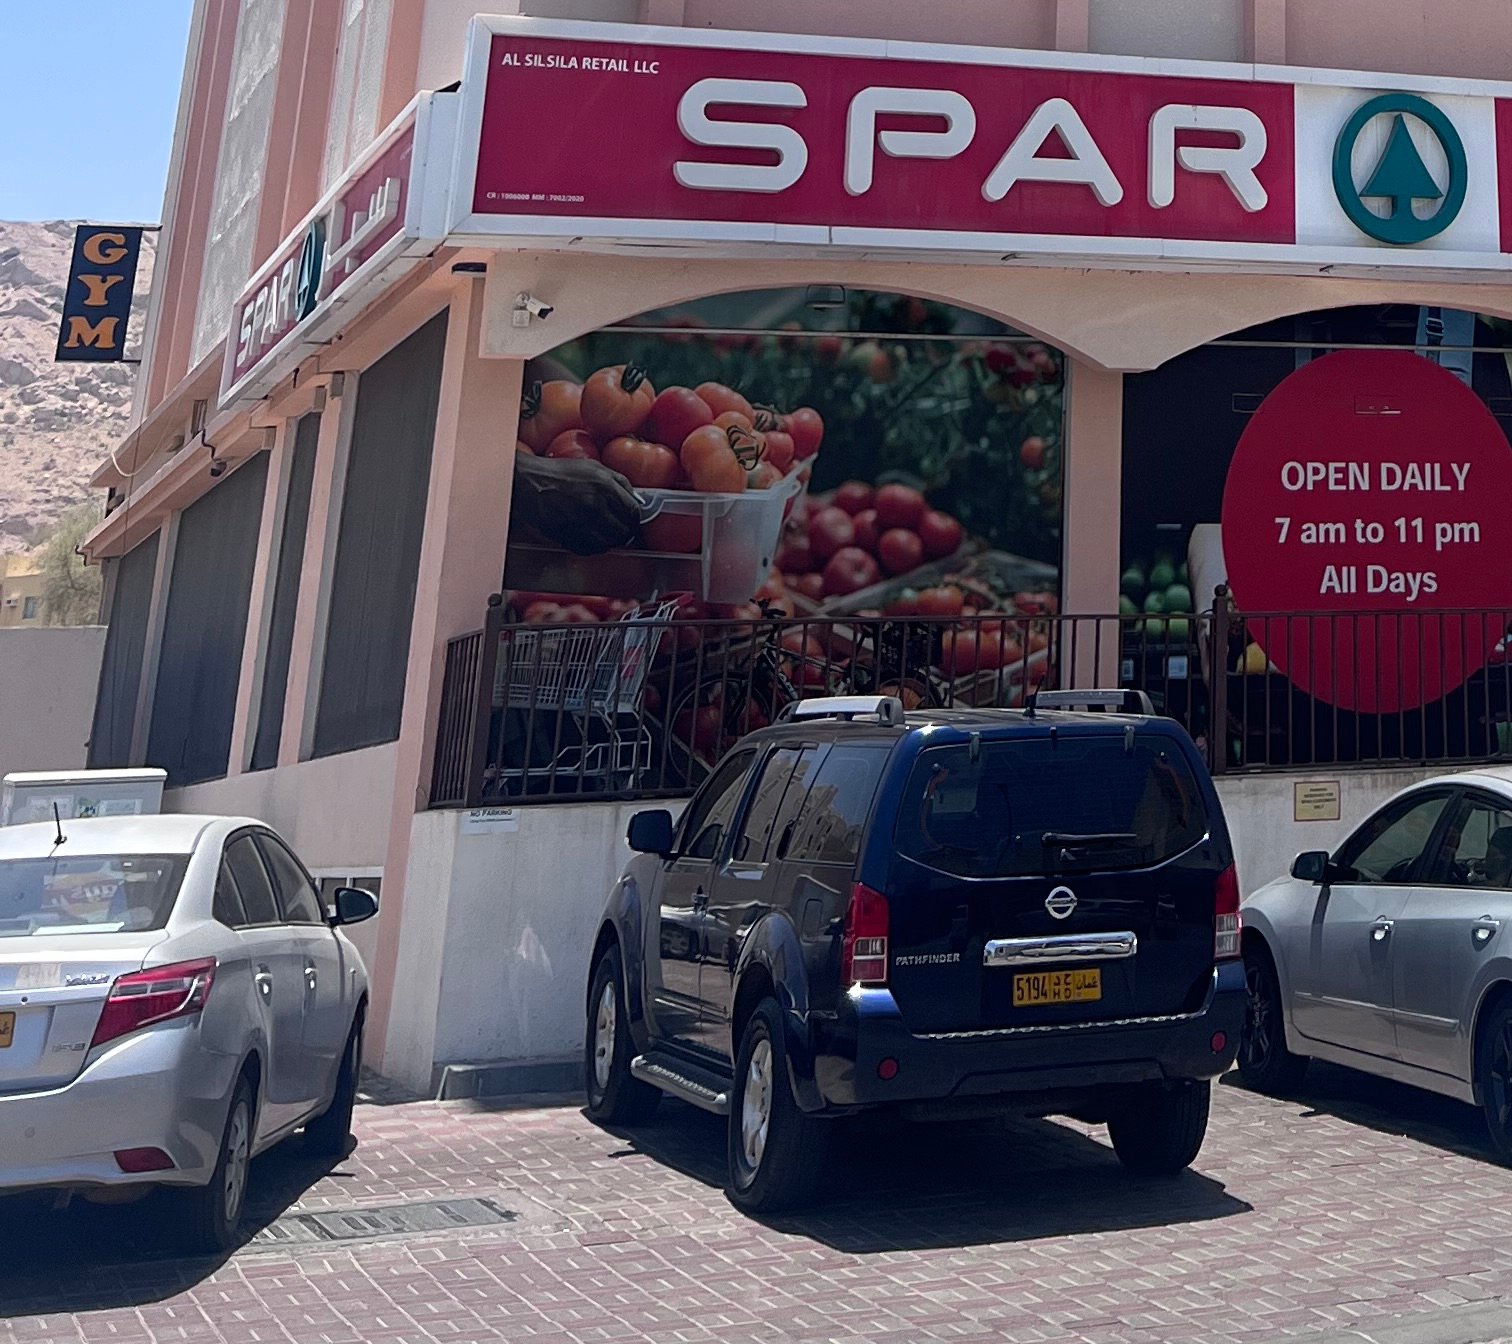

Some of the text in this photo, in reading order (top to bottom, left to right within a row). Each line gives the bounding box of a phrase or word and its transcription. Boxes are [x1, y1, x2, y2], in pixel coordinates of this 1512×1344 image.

[501, 53, 660, 75] AL SILSILA RETAIL LLC
[673, 77, 1269, 212] SPAR
[63, 232, 129, 349] GYM
[1281, 460, 1471, 491] OPEN DAILY
[1274, 517, 1480, 551] 7 am to 11 pm
[1319, 565, 1438, 602] All Days
[895, 953, 961, 966] PATHFINDER
[1016, 975, 1048, 1001] 5194
[1075, 976, 1099, 991] عمان
